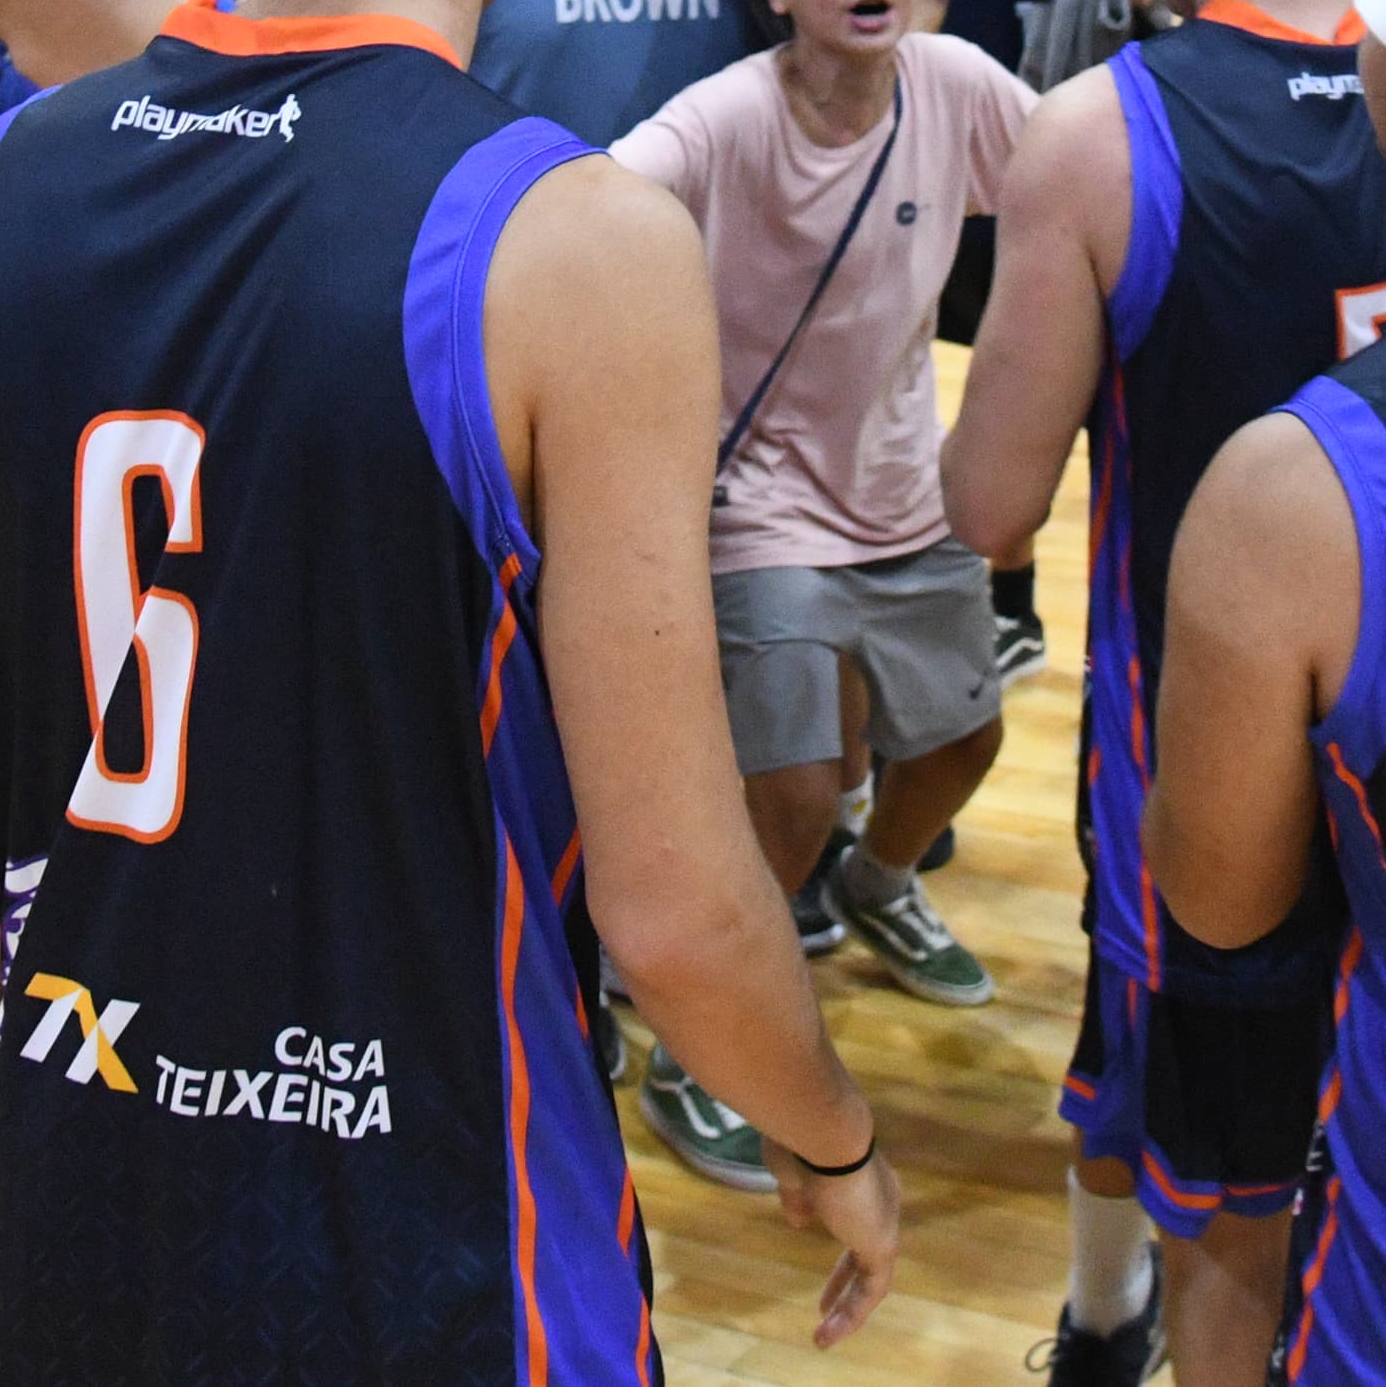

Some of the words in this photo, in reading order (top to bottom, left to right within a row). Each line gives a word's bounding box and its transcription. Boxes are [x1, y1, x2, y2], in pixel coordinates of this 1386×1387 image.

[110, 94, 293, 141] playmaker
[65, 409, 206, 845] 6
[273, 1025, 386, 1082] CASA
[155, 1054, 393, 1140] TEIXEIRA
